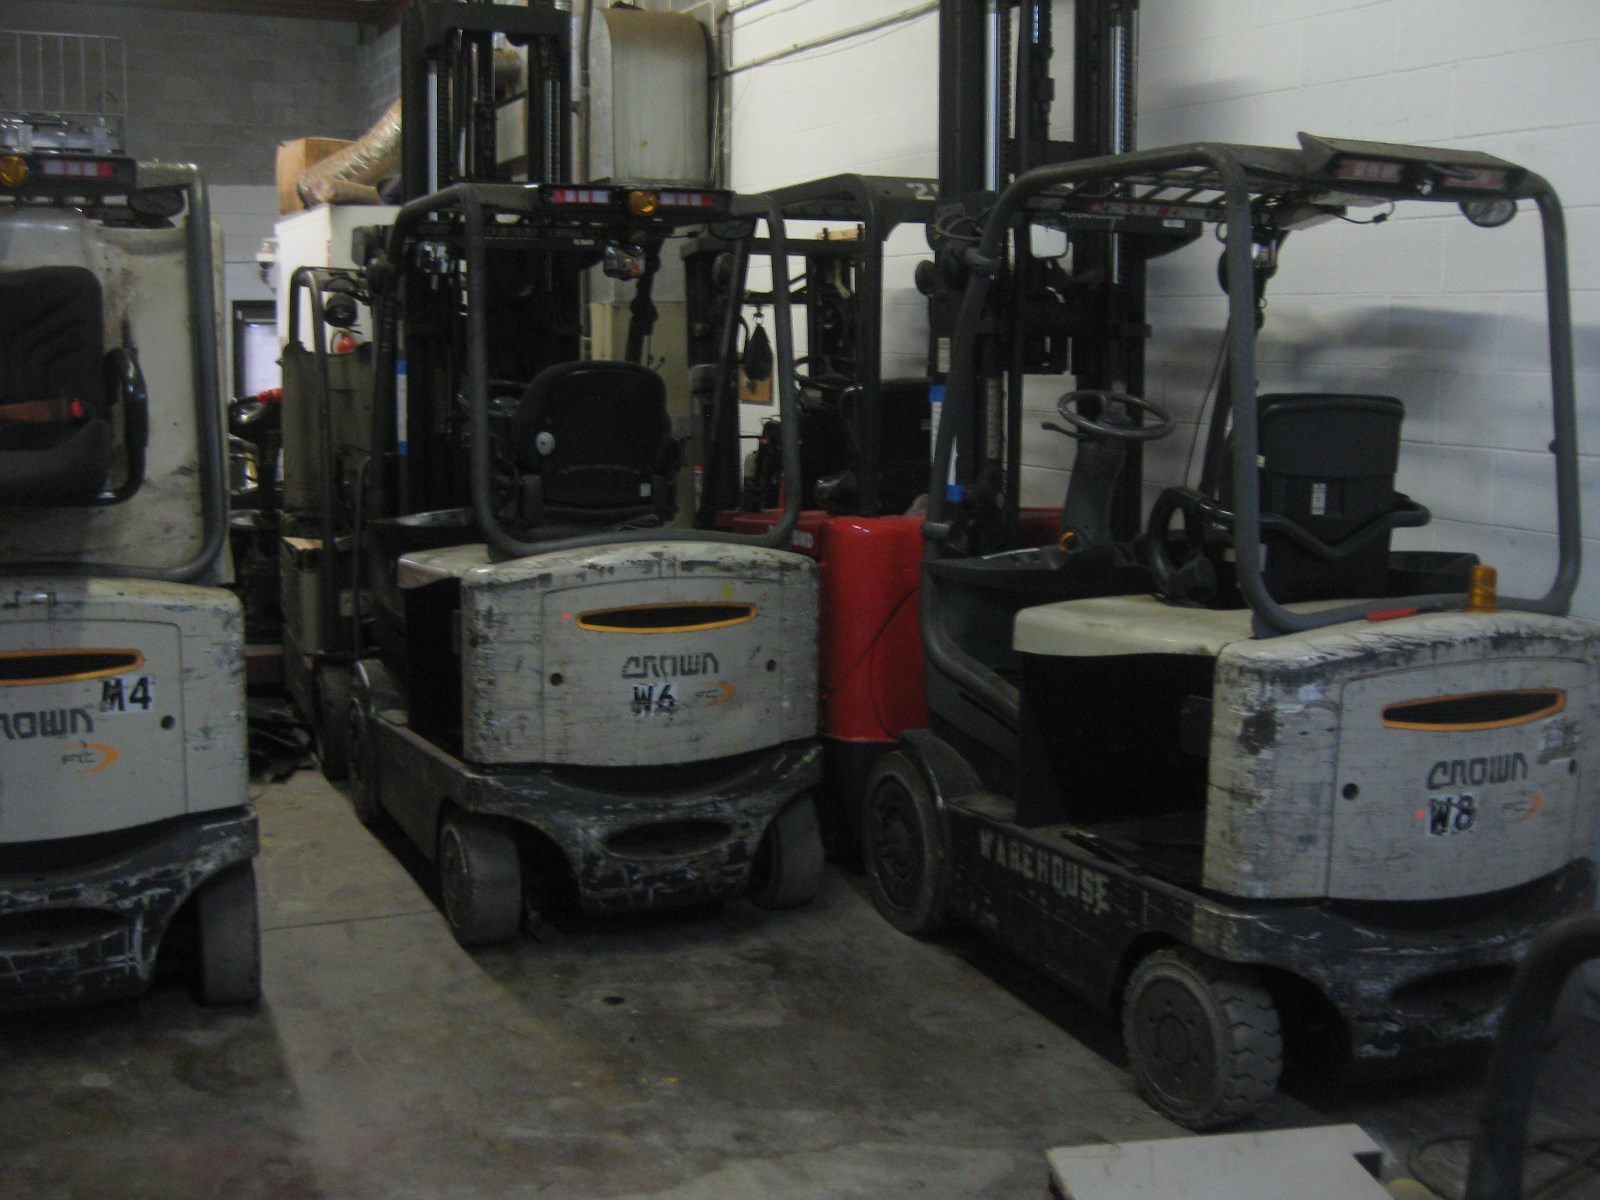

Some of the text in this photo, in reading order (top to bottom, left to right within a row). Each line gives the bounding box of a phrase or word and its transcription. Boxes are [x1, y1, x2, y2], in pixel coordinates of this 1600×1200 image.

[621, 652, 720, 679] CROWN
[632, 684, 676, 715] W6
[1426, 752, 1528, 790] CROWN
[1429, 795, 1475, 836] W8
[978, 828, 1111, 915] WAREHOUSE
